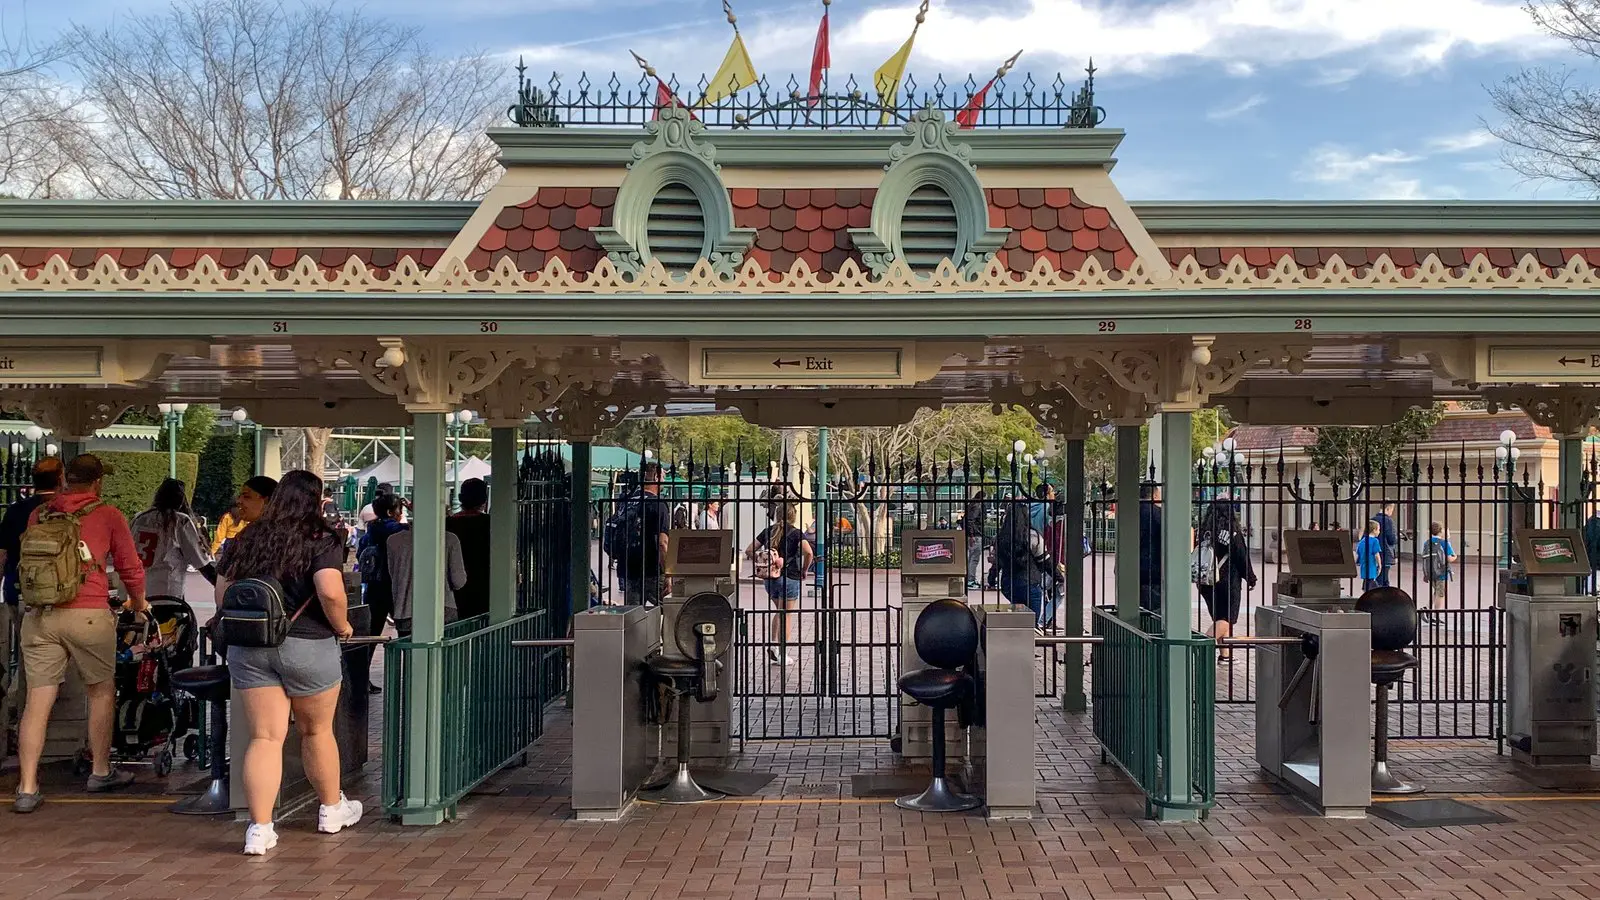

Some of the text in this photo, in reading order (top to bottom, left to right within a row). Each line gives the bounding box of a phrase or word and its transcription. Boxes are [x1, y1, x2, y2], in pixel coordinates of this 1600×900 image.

[272, 321, 288, 332] 31
[480, 321, 497, 332] 30
[1098, 321, 1116, 331] 29
[1294, 319, 1311, 329] 28
[805, 356, 833, 370] Exit
